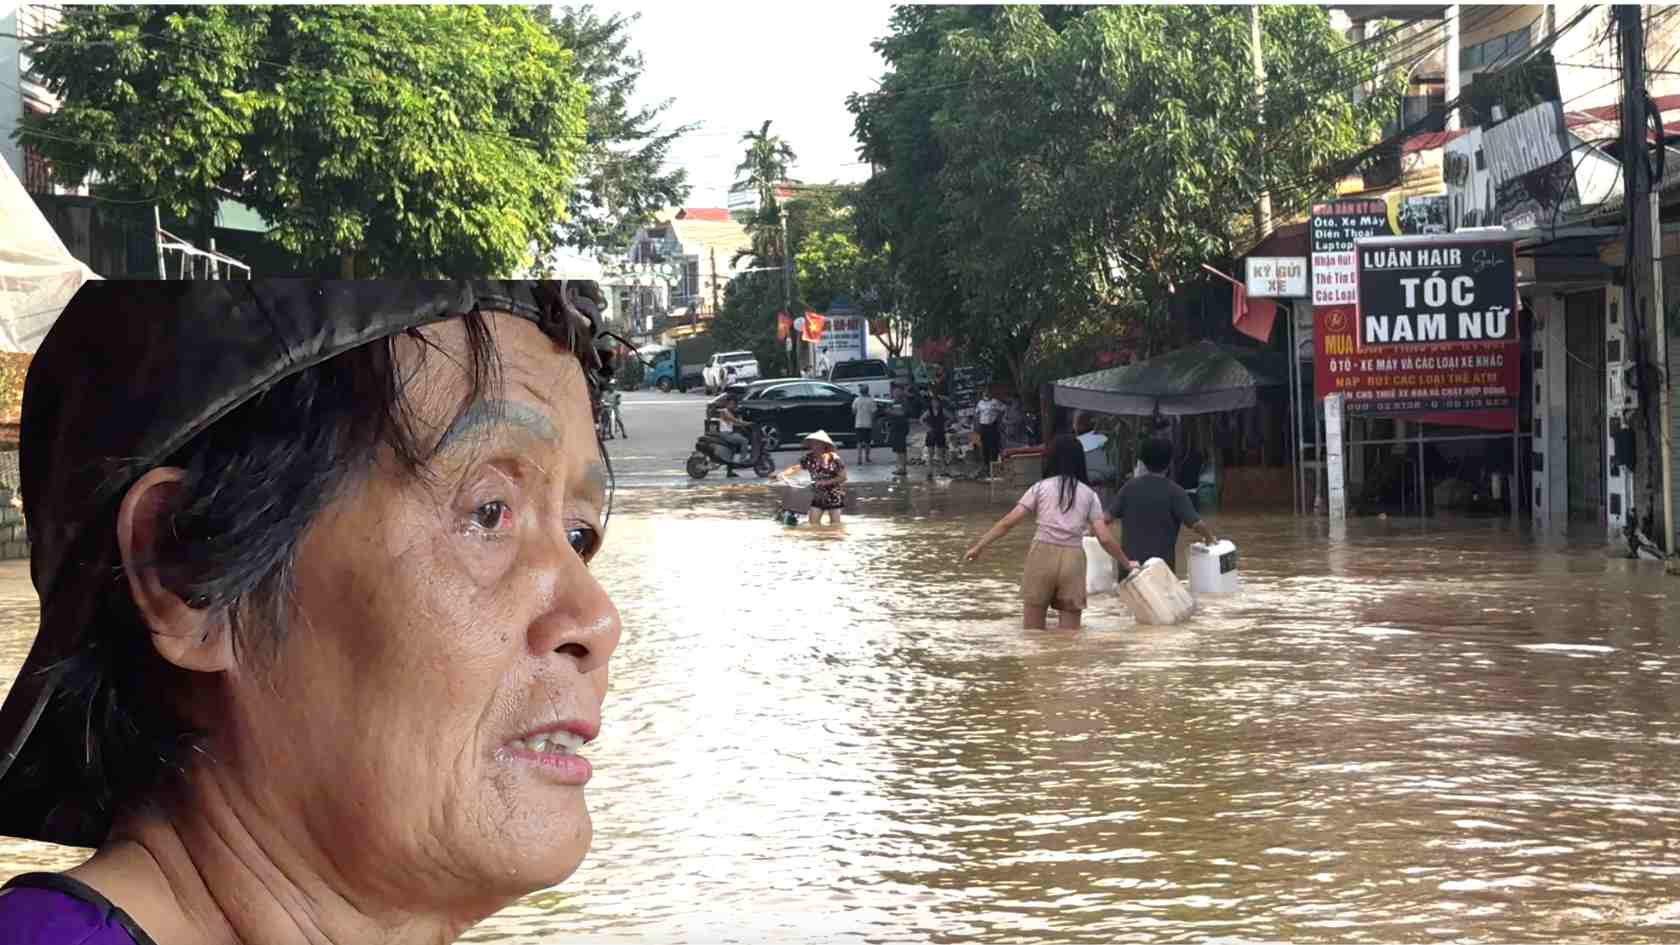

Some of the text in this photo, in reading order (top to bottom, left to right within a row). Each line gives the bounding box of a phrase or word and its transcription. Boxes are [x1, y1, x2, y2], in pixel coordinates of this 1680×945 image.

[1342, 217, 1357, 226] Xe
[1360, 216, 1385, 226] Máy
[1315, 241, 1353, 253] Laptop
[1364, 248, 1412, 268] LUÂN
[1417, 248, 1461, 266] HAIR
[1268, 279, 1287, 292] XE
[1400, 270, 1475, 308] TÓC
[1366, 305, 1511, 342] NAM NỮ
[1325, 334, 1354, 355] MUA
[1360, 359, 1373, 371] XE
[1460, 355, 1473, 368] XE
